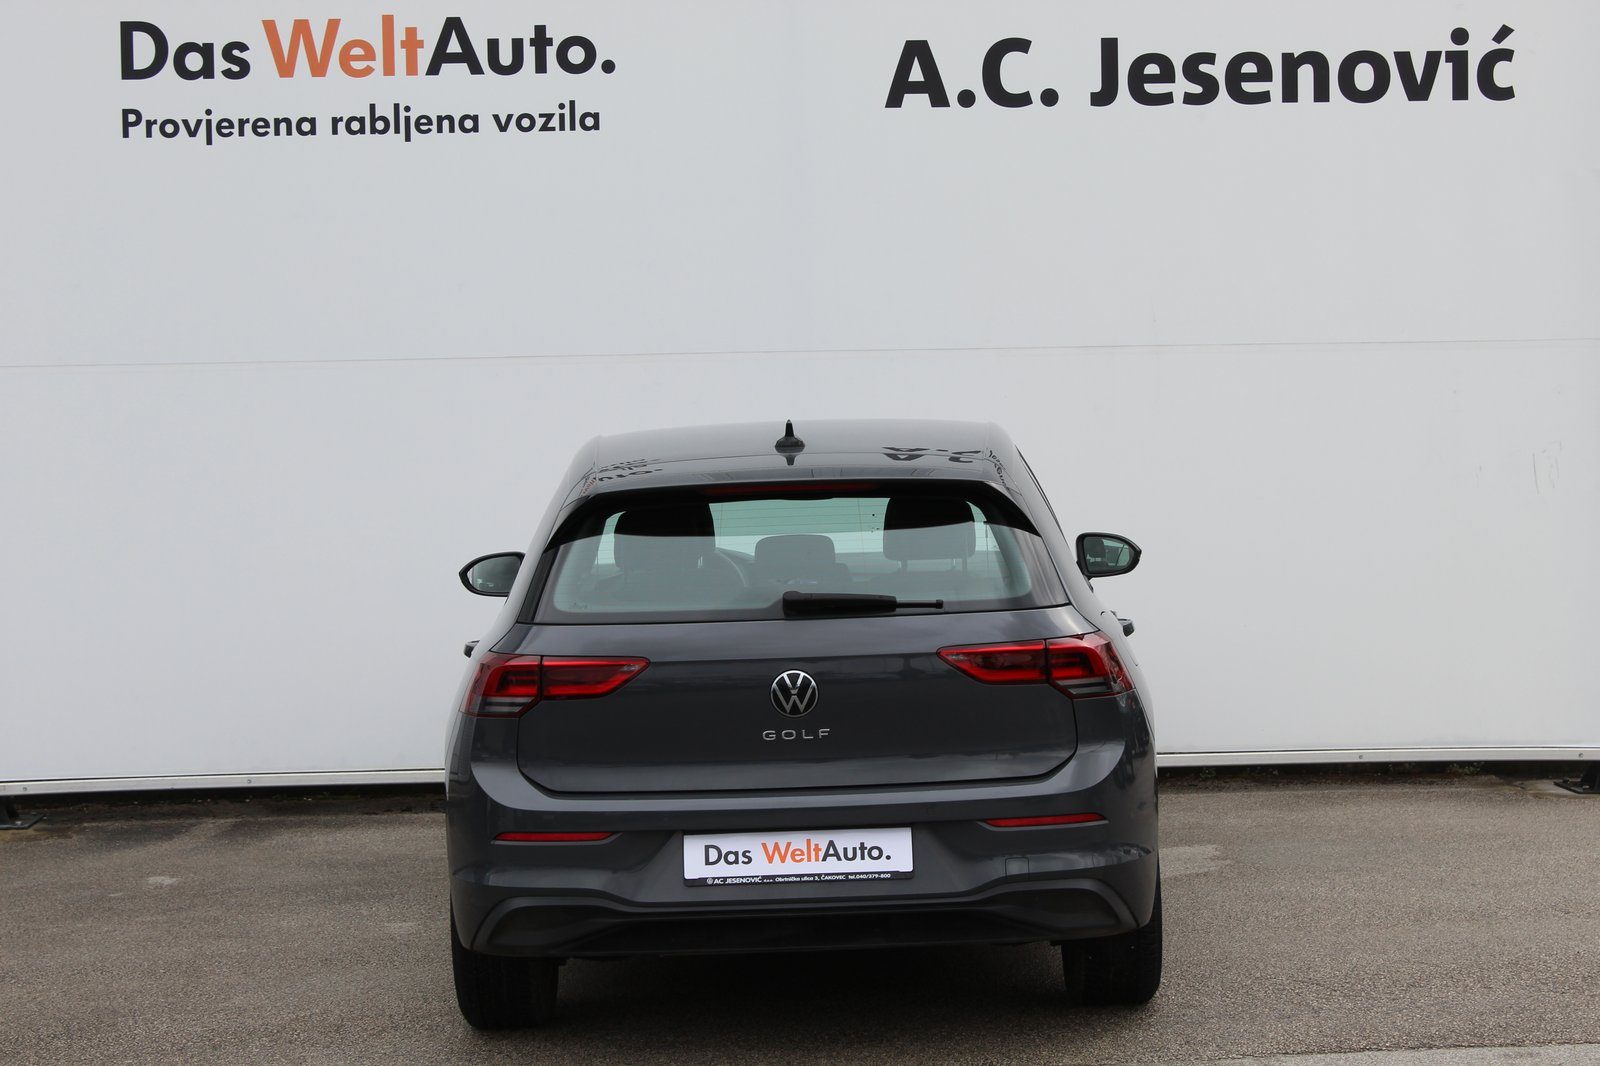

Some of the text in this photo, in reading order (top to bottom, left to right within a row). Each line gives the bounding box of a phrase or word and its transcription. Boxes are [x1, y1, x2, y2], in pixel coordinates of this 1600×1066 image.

[119, 14, 617, 81] Das WeltAuto.
[885, 24, 1516, 108] A.C. Jesenović
[121, 100, 601, 146] Provjerena rabljena vozila
[762, 728, 831, 741] GOLF
[704, 838, 892, 866] Das WeltAuto.
[725, 875, 762, 885] JESENOVIĆ
